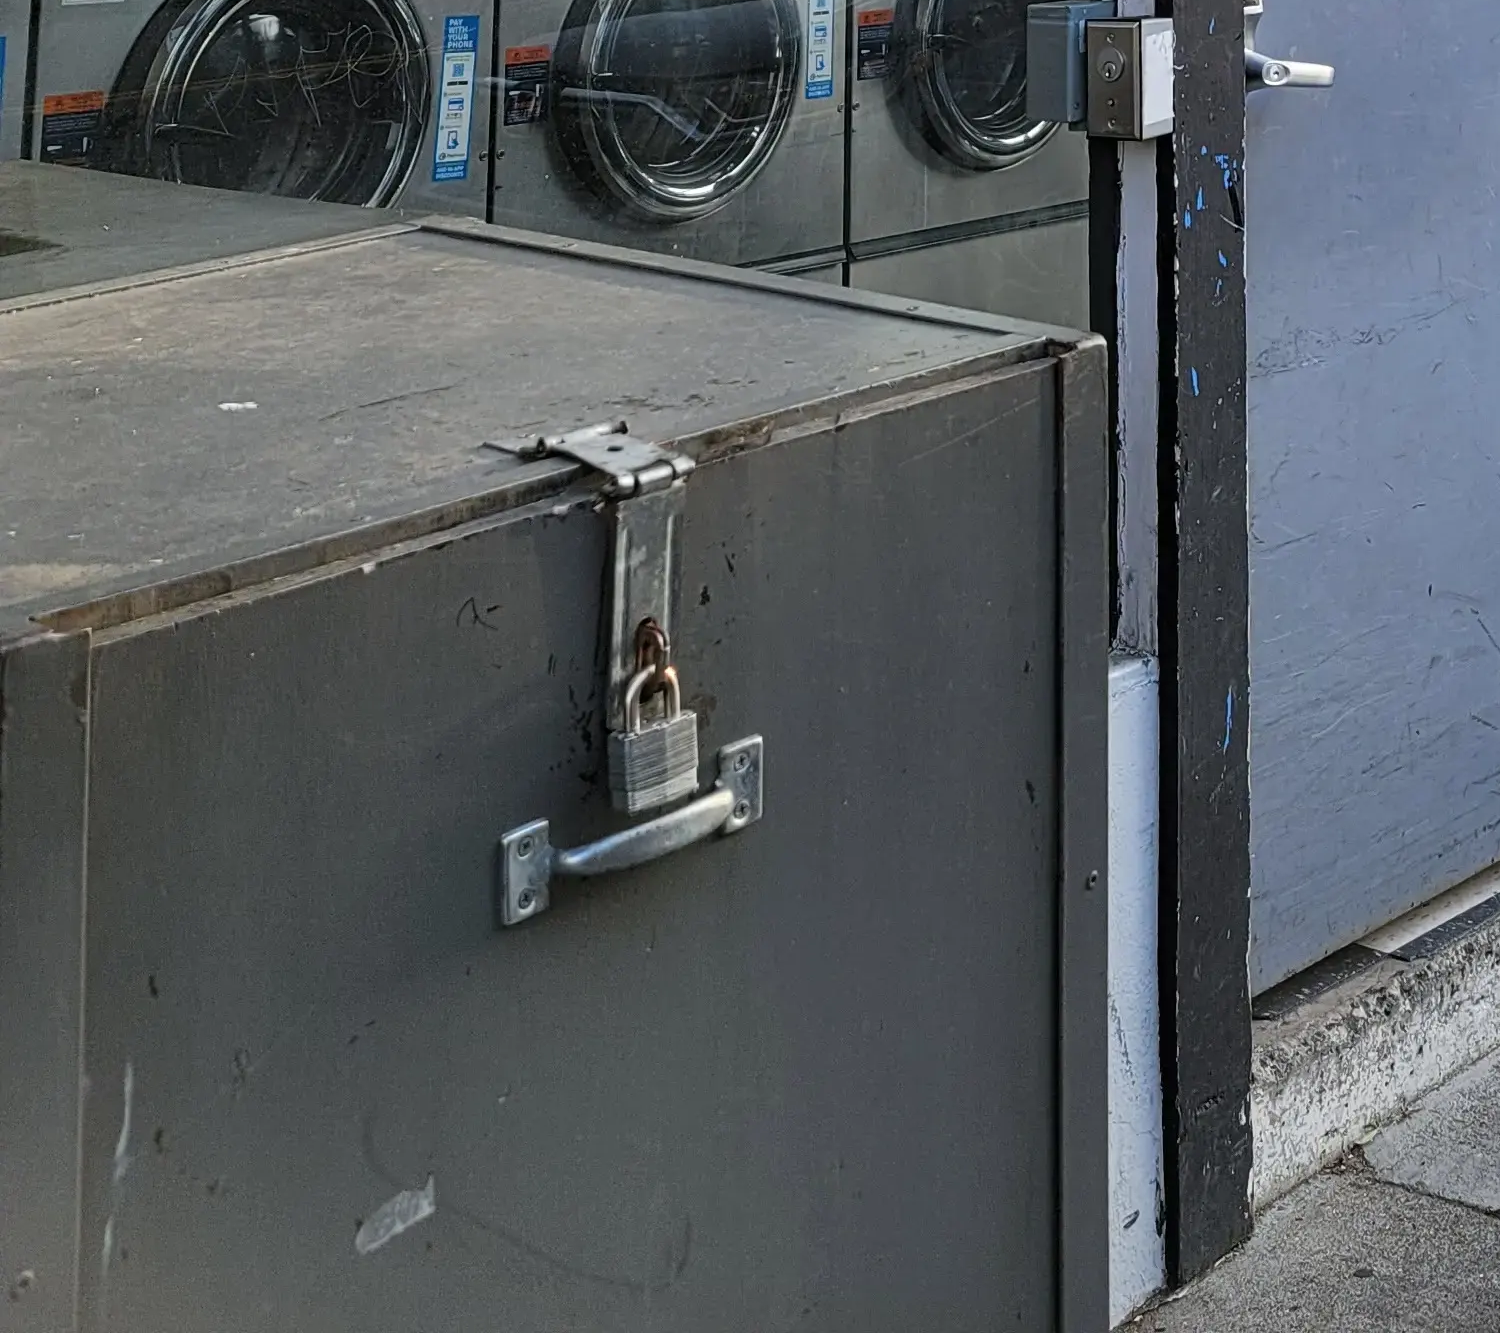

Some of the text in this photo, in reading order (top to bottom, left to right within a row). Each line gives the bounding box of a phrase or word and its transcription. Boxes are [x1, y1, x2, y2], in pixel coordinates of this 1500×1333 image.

[449, 18, 464, 26] PAY
[448, 25, 469, 34] WITH
[447, 33, 469, 41] YOUR
[447, 40, 474, 49] PHONE
